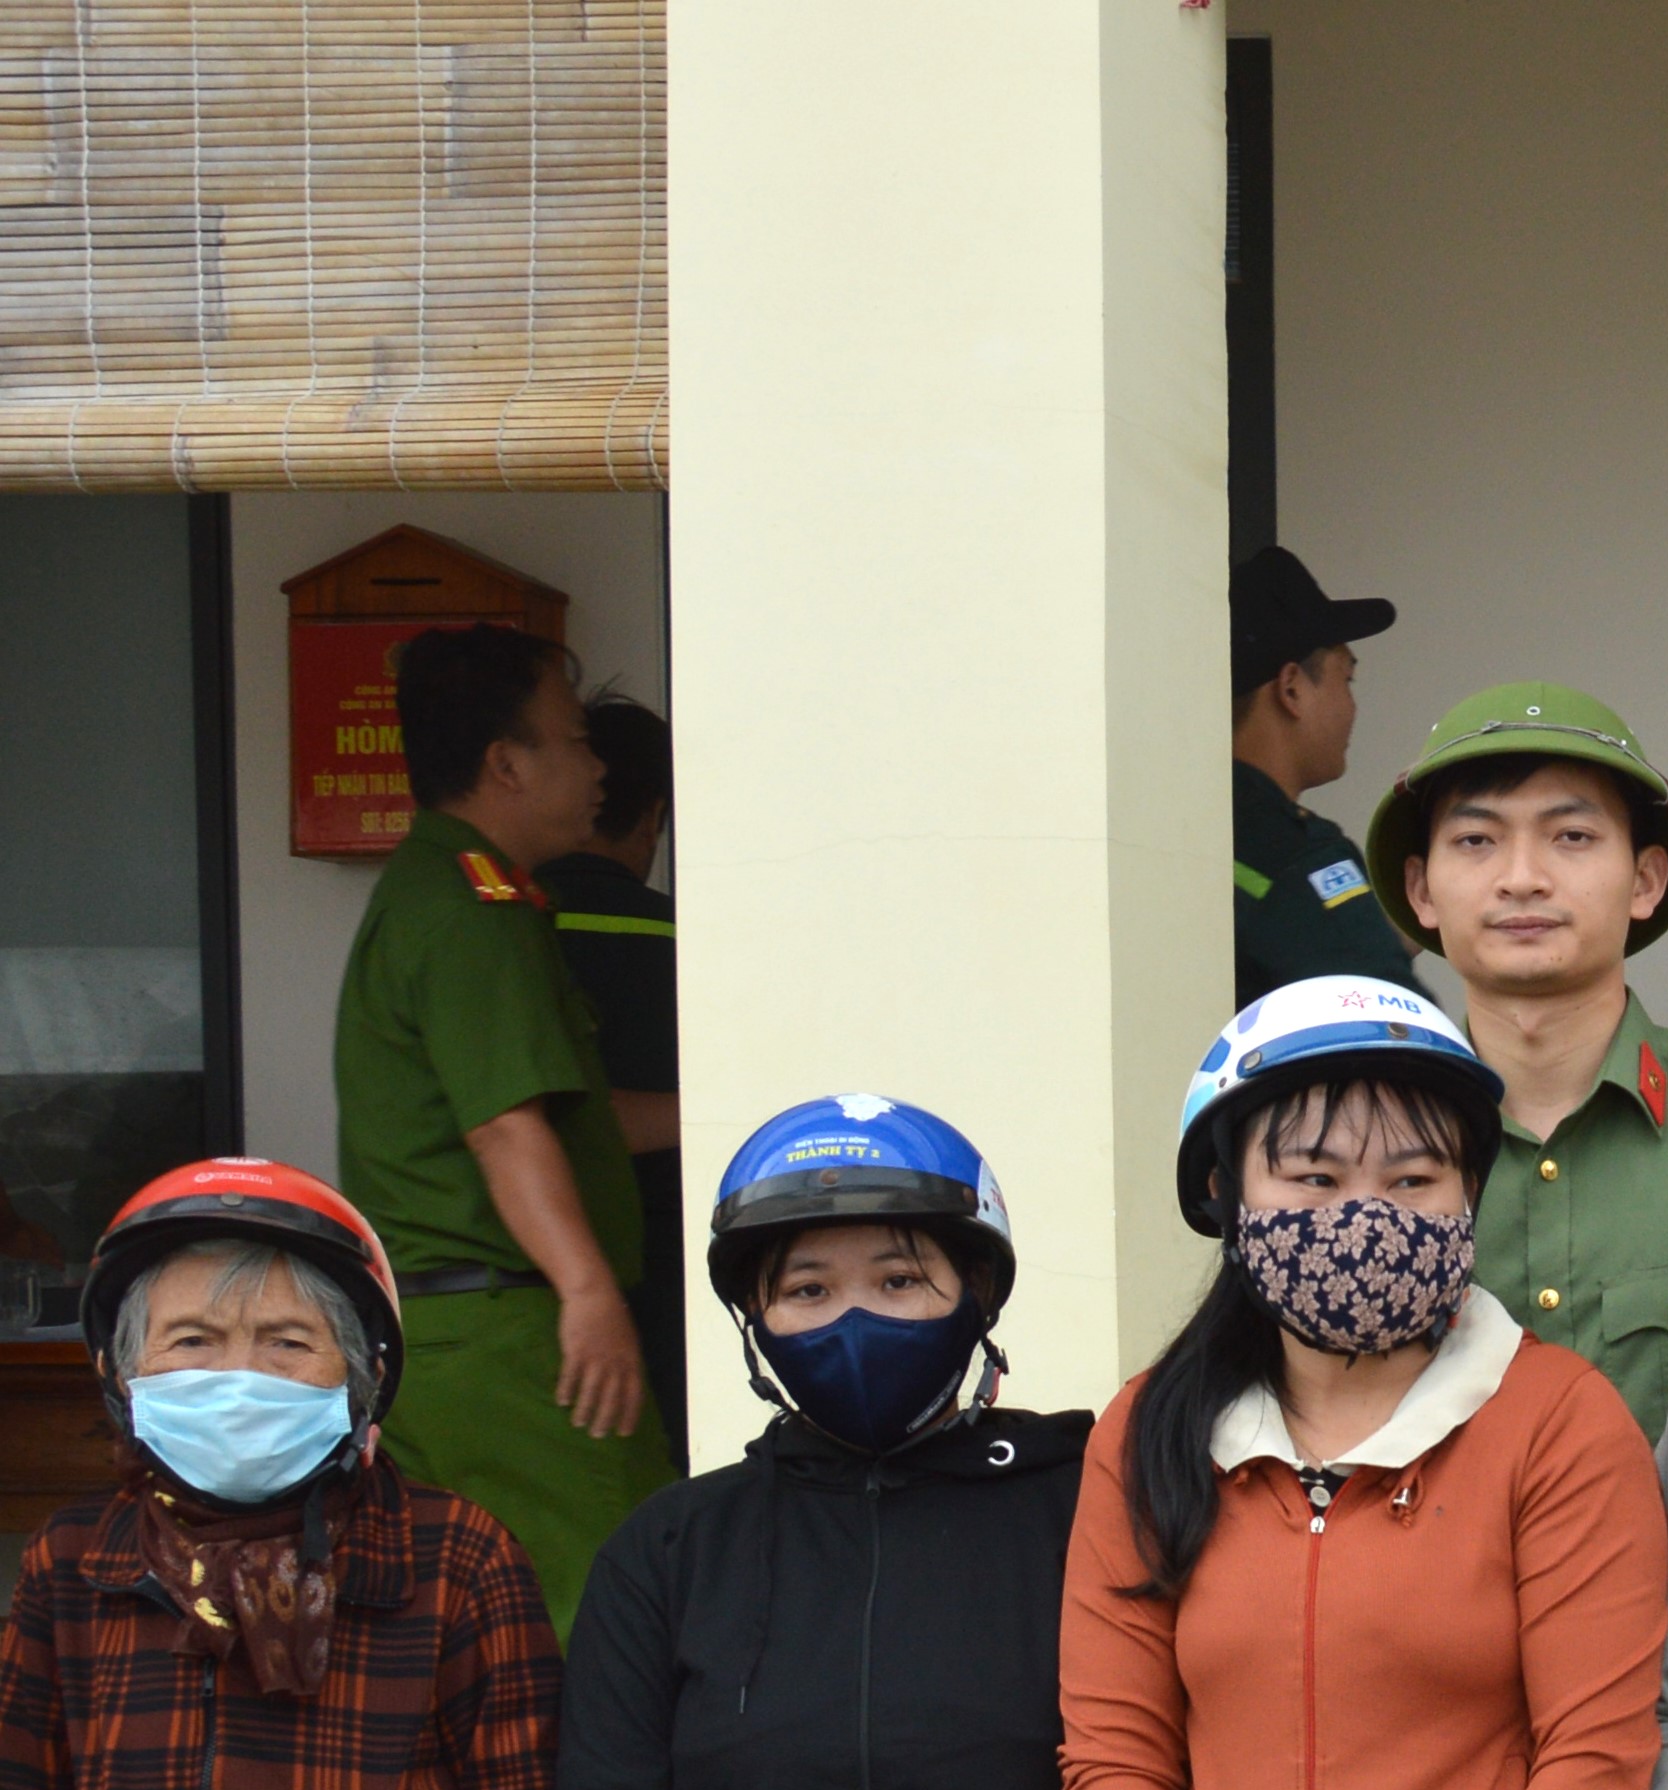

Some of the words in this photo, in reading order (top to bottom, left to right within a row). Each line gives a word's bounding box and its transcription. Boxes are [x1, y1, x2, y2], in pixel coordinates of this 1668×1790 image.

[337, 718, 404, 755] HÒM
[1378, 994, 1422, 1015] MB
[786, 1145, 841, 1163] THÀNH
